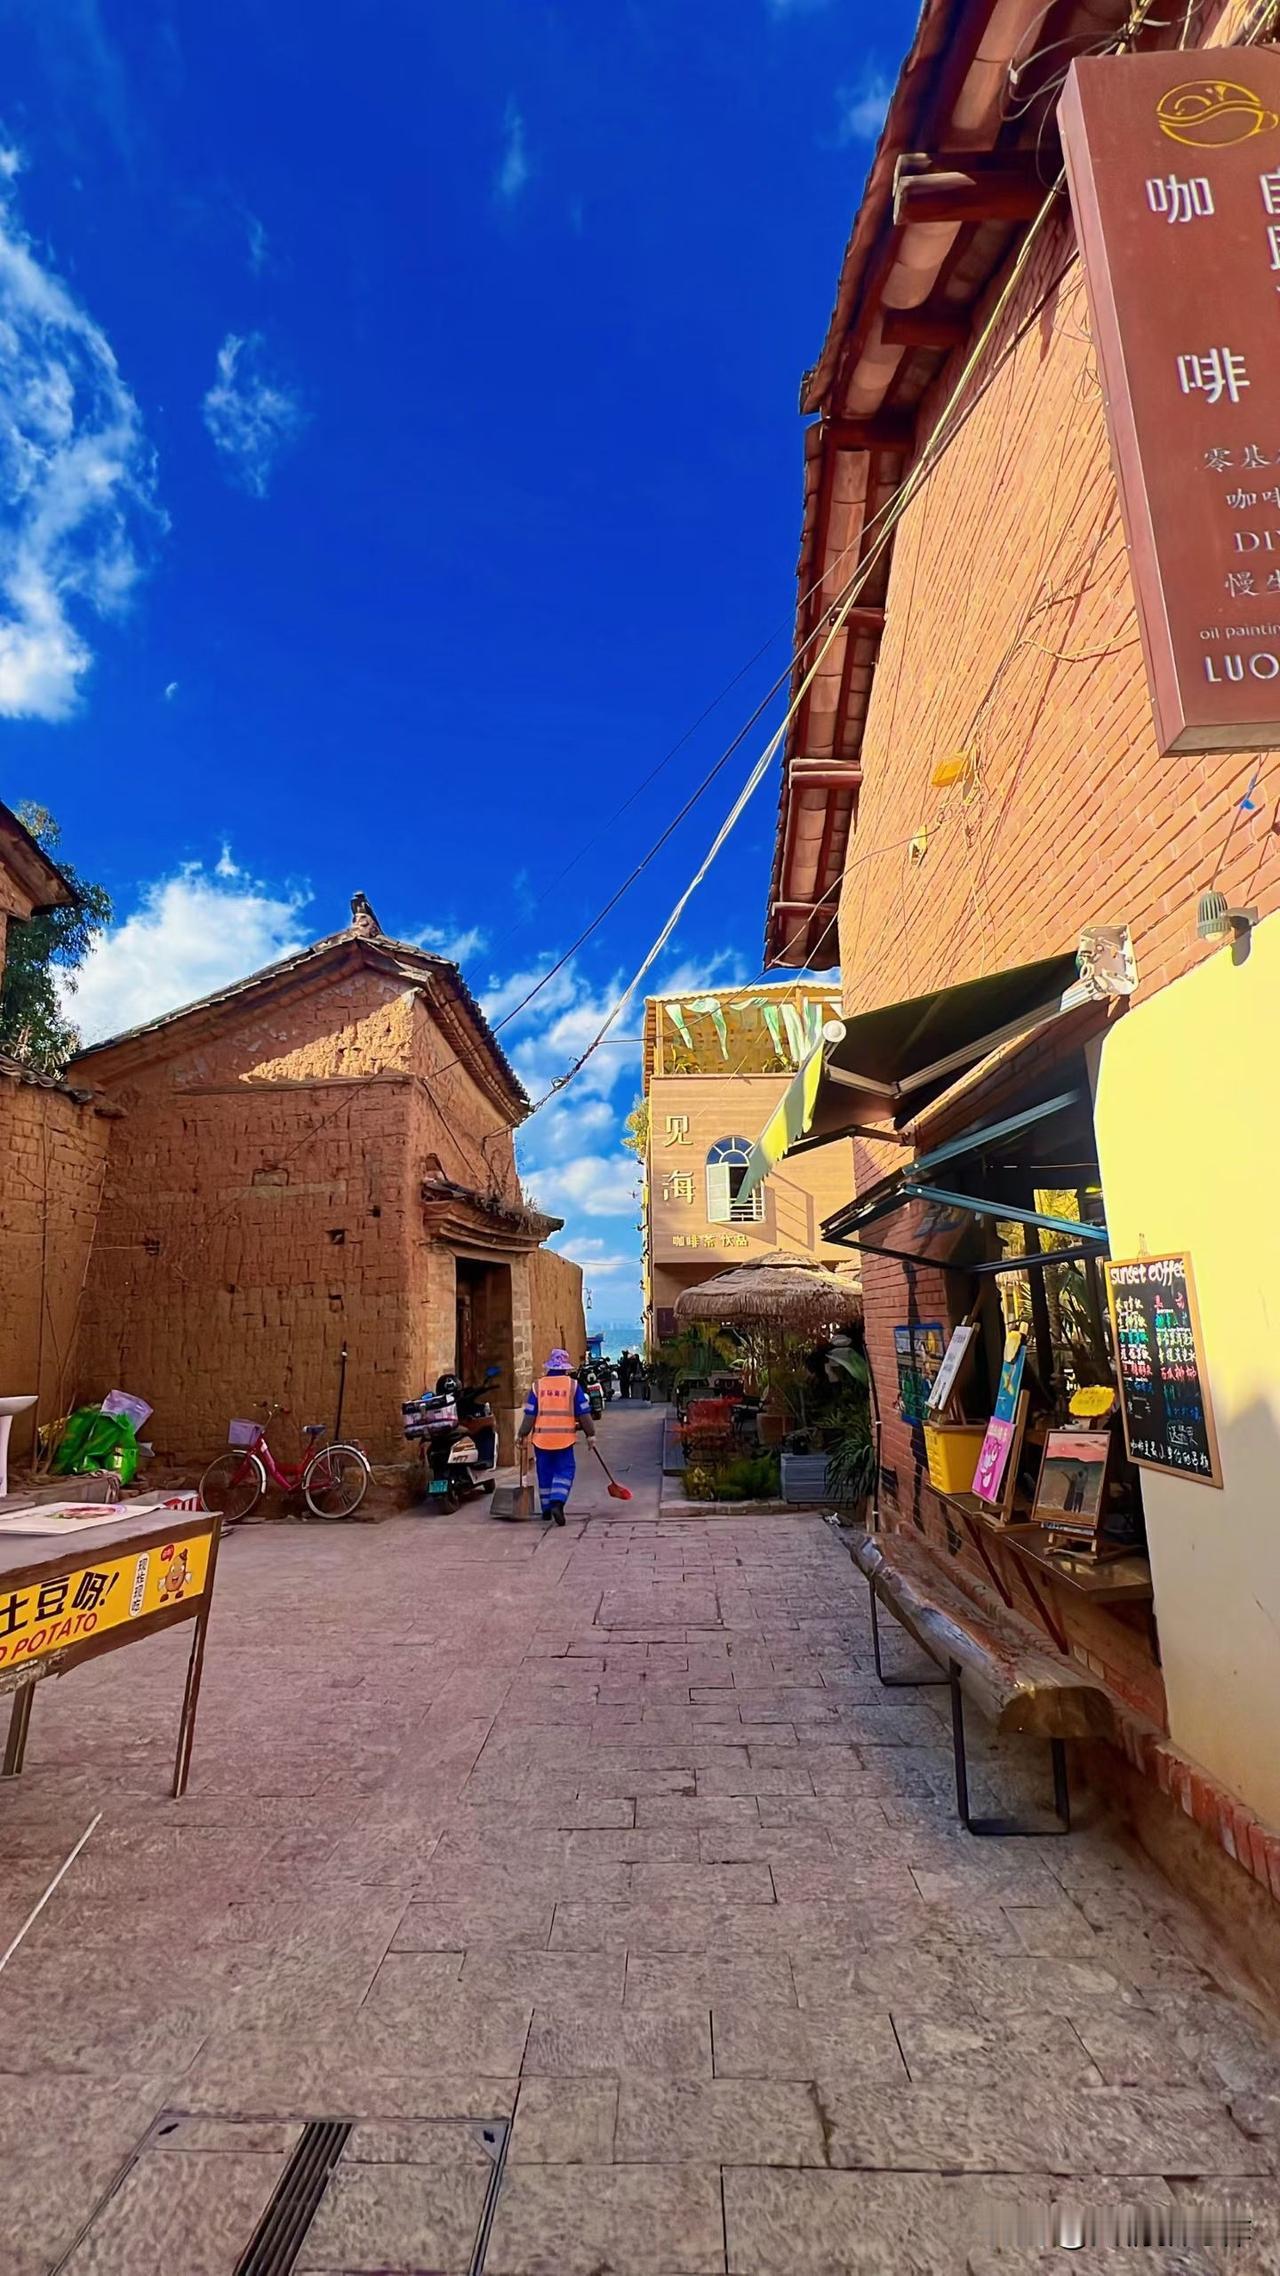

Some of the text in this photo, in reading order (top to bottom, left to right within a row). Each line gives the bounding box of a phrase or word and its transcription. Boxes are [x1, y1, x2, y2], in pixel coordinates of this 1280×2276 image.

[1204, 444, 1280, 472] 零基
[1235, 530, 1280, 553] DI
[1200, 626, 1219, 640] oil
[1110, 1259, 1185, 1287] sunset coffee
[10, 1612, 98, 1660] POTATO
